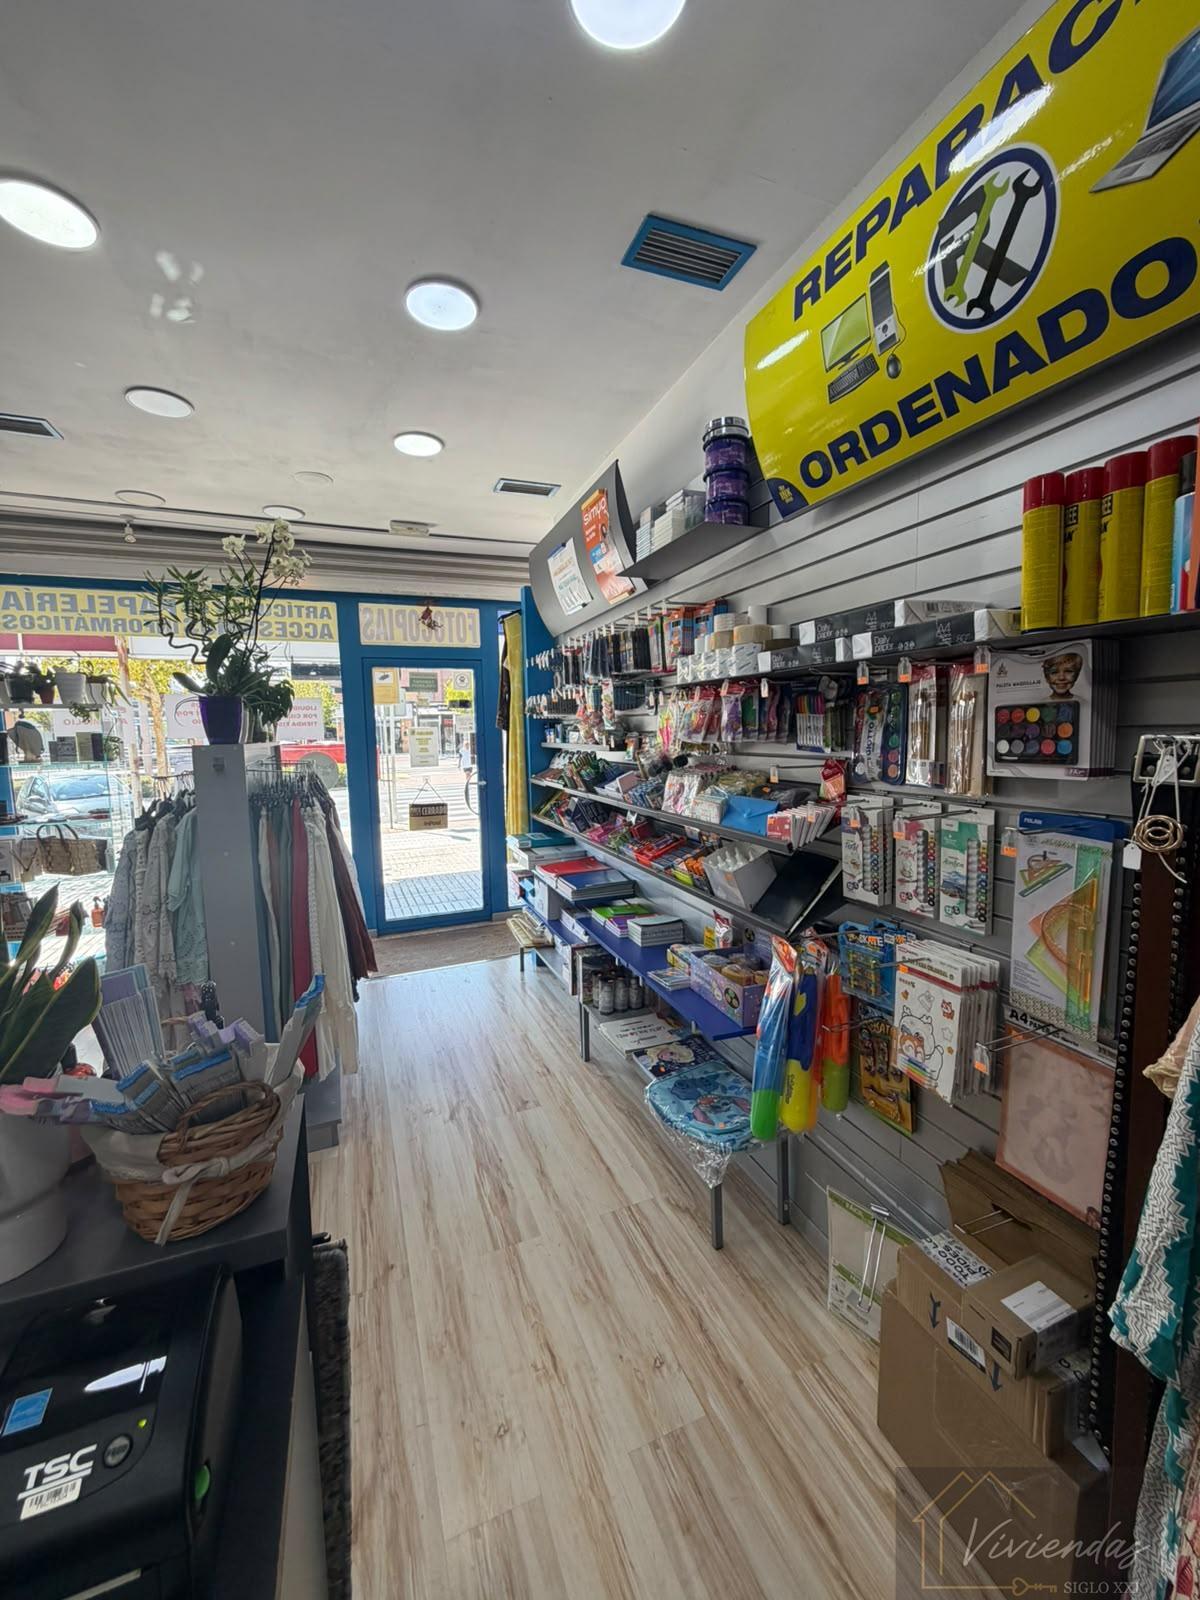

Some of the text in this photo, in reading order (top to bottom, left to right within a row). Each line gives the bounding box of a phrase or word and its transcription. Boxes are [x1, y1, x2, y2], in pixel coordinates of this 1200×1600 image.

[793, 0, 1141, 322] REPARAC
[799, 236, 1198, 490] ORDENADO
[24, 1443, 98, 1490] TSC
